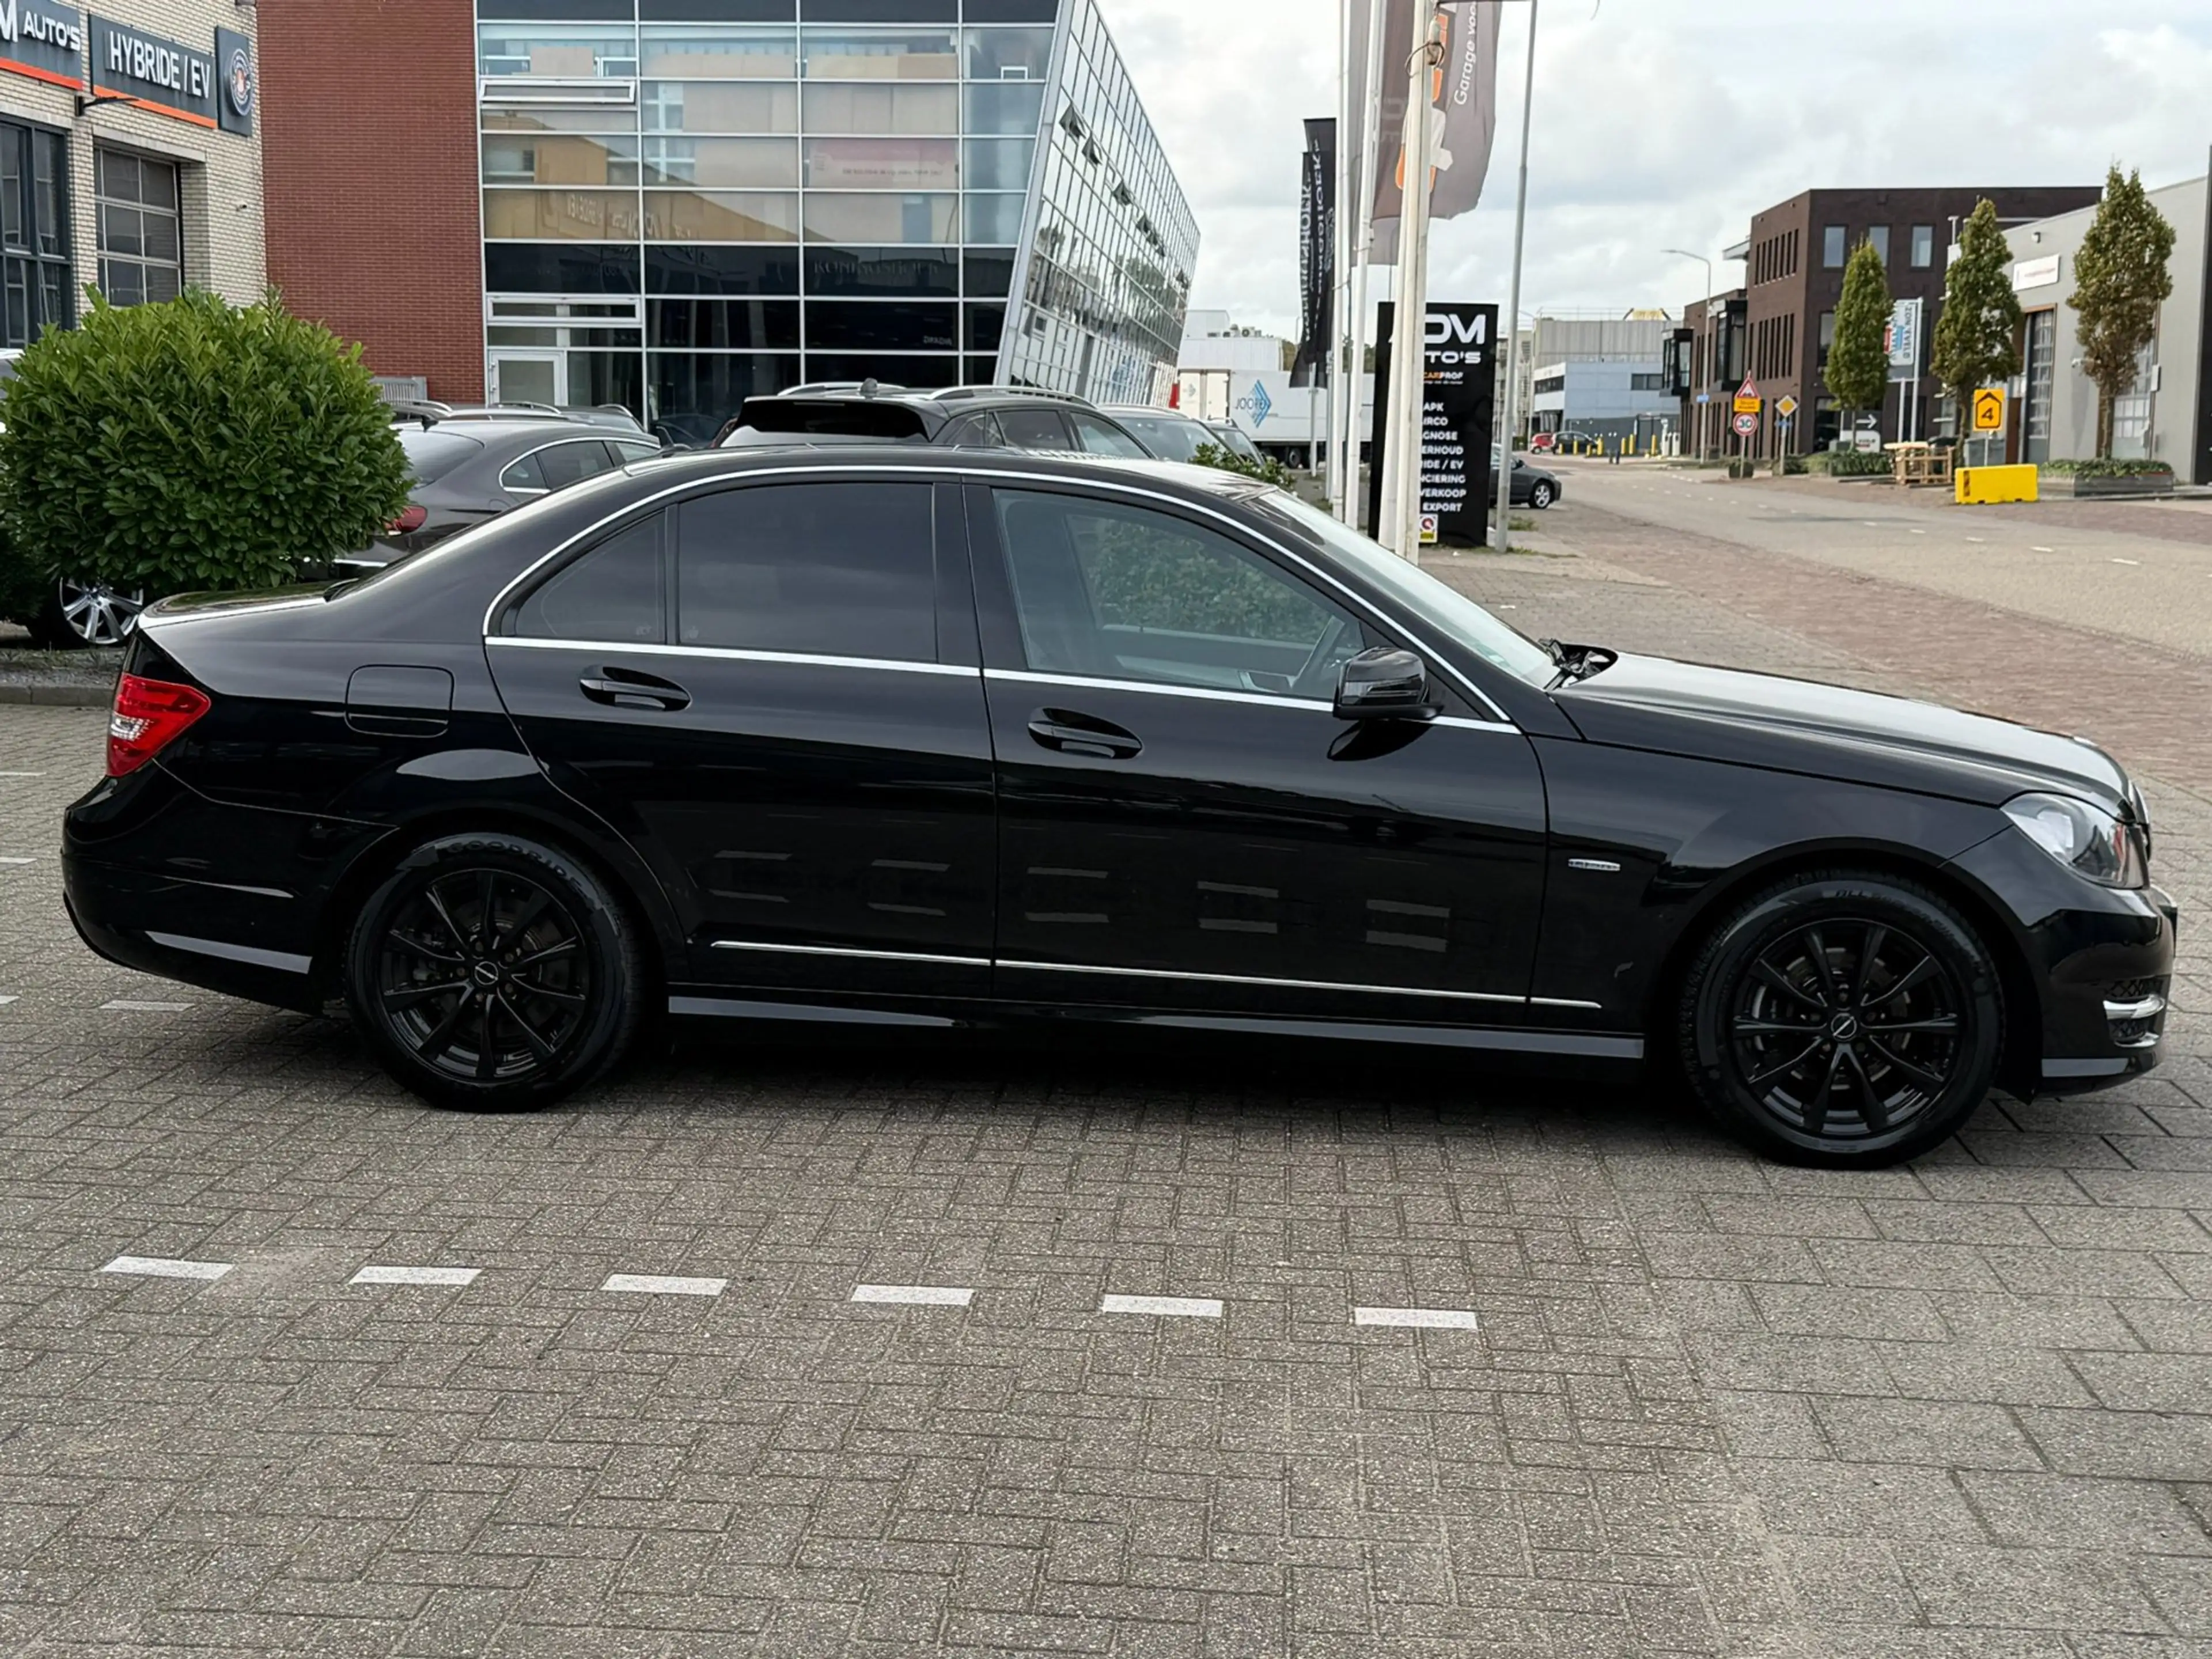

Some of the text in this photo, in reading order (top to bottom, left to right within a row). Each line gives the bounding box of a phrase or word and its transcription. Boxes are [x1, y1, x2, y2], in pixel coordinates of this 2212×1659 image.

[23, 10, 81, 51] AUTO'S
[1454, 2, 1477, 105] Garage voo
[110, 31, 180, 89] HYBRIDE
[191, 58, 211, 99] EV
[1388, 313, 1486, 344] DM
[1425, 351, 1482, 364] TO'S
[1423, 402, 1444, 411] APK
[1981, 407, 1994, 422] 4
[1423, 416, 1449, 426] IRCO
[1740, 418, 1753, 429] 30
[1423, 431, 1459, 441] GNOSE
[1422, 445, 1464, 455] ERHOUD
[1450, 460, 1464, 470] EV
[1421, 474, 1466, 483] CIERING
[1422, 502, 1463, 512] EXPORT
[446, 840, 585, 896] GOODRIDE
